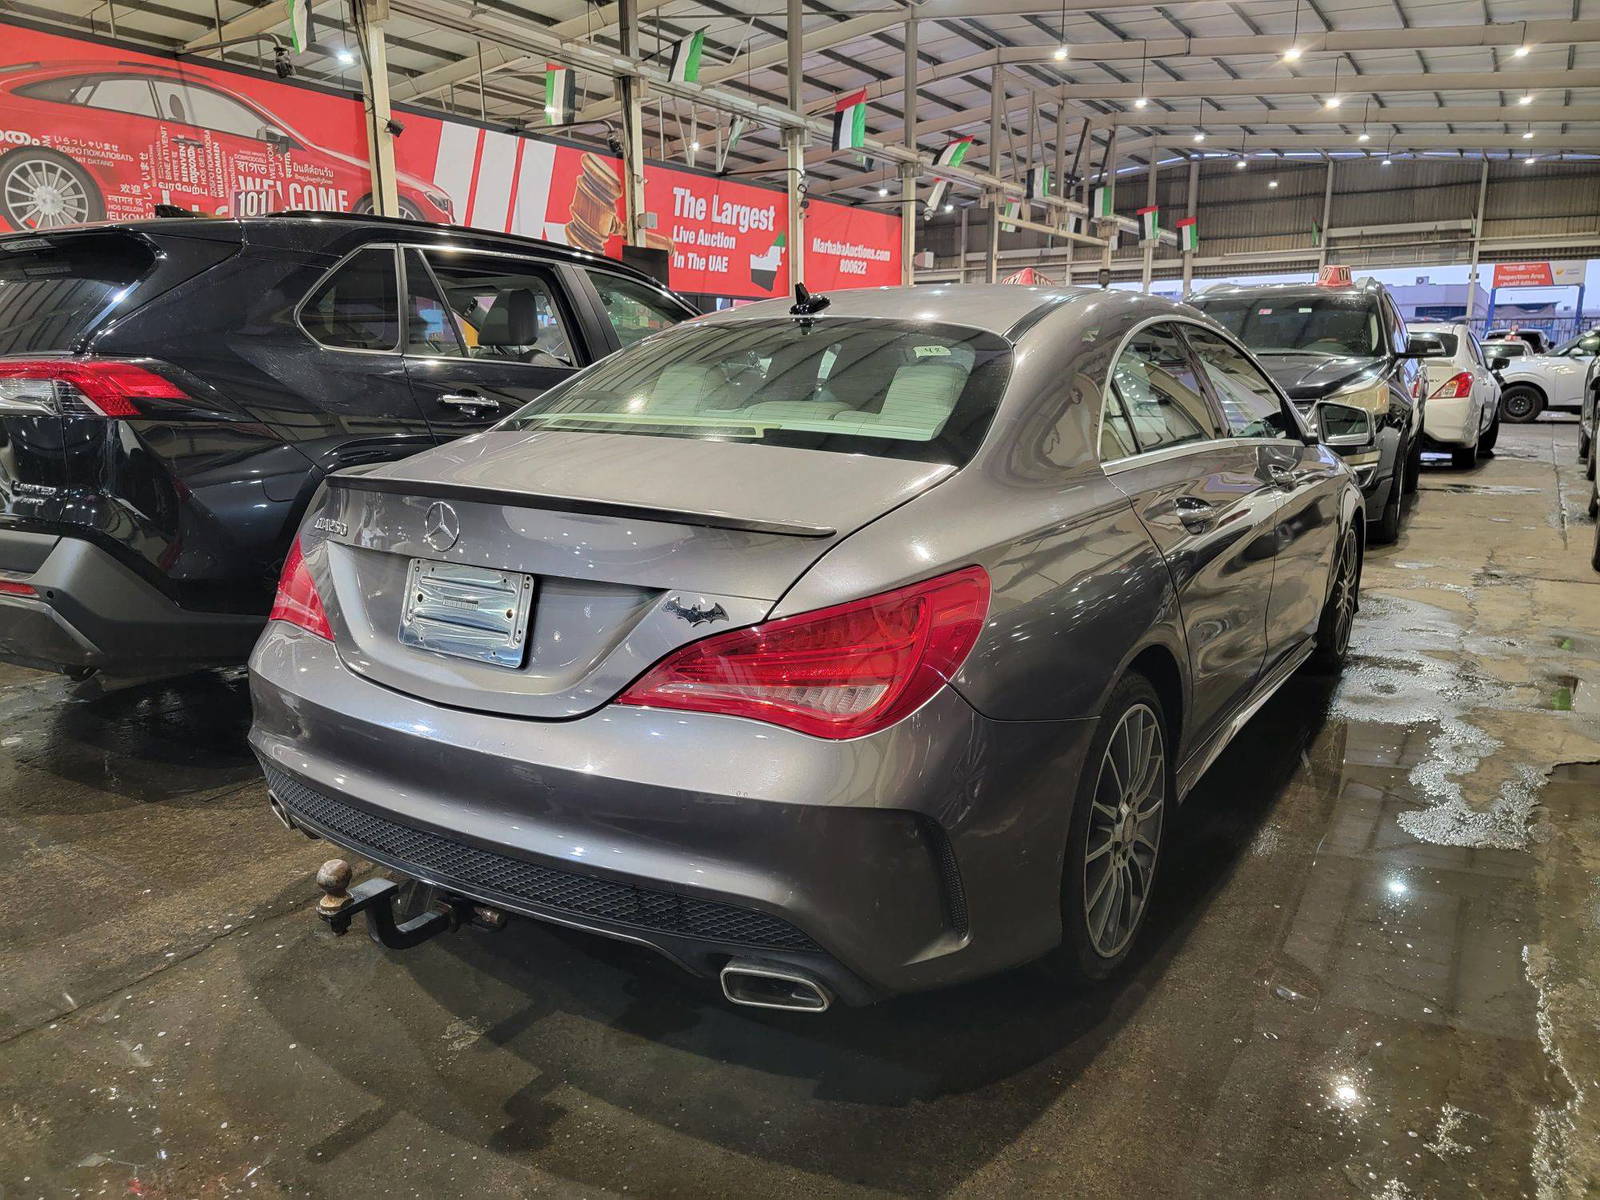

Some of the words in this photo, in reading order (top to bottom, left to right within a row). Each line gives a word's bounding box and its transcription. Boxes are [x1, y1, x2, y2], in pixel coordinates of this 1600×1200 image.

[178, 134, 189, 182] BIENVENE
[204, 130, 214, 171] ПОЖАЛОВА
[213, 142, 224, 198] WILLKOMMEN
[139, 152, 155, 219] らっしゃいませ
[238, 175, 348, 214] WECOME
[238, 191, 268, 216] 101
[107, 211, 144, 220] ELKOM
[673, 187, 707, 221] The
[711, 194, 775, 234] Largest
[673, 224, 696, 244] Live
[697, 229, 736, 249] Auction
[812, 237, 891, 262] MarhabaAuctions.com
[673, 251, 685, 268] In
[687, 252, 706, 270] The
[708, 254, 728, 273] UAE
